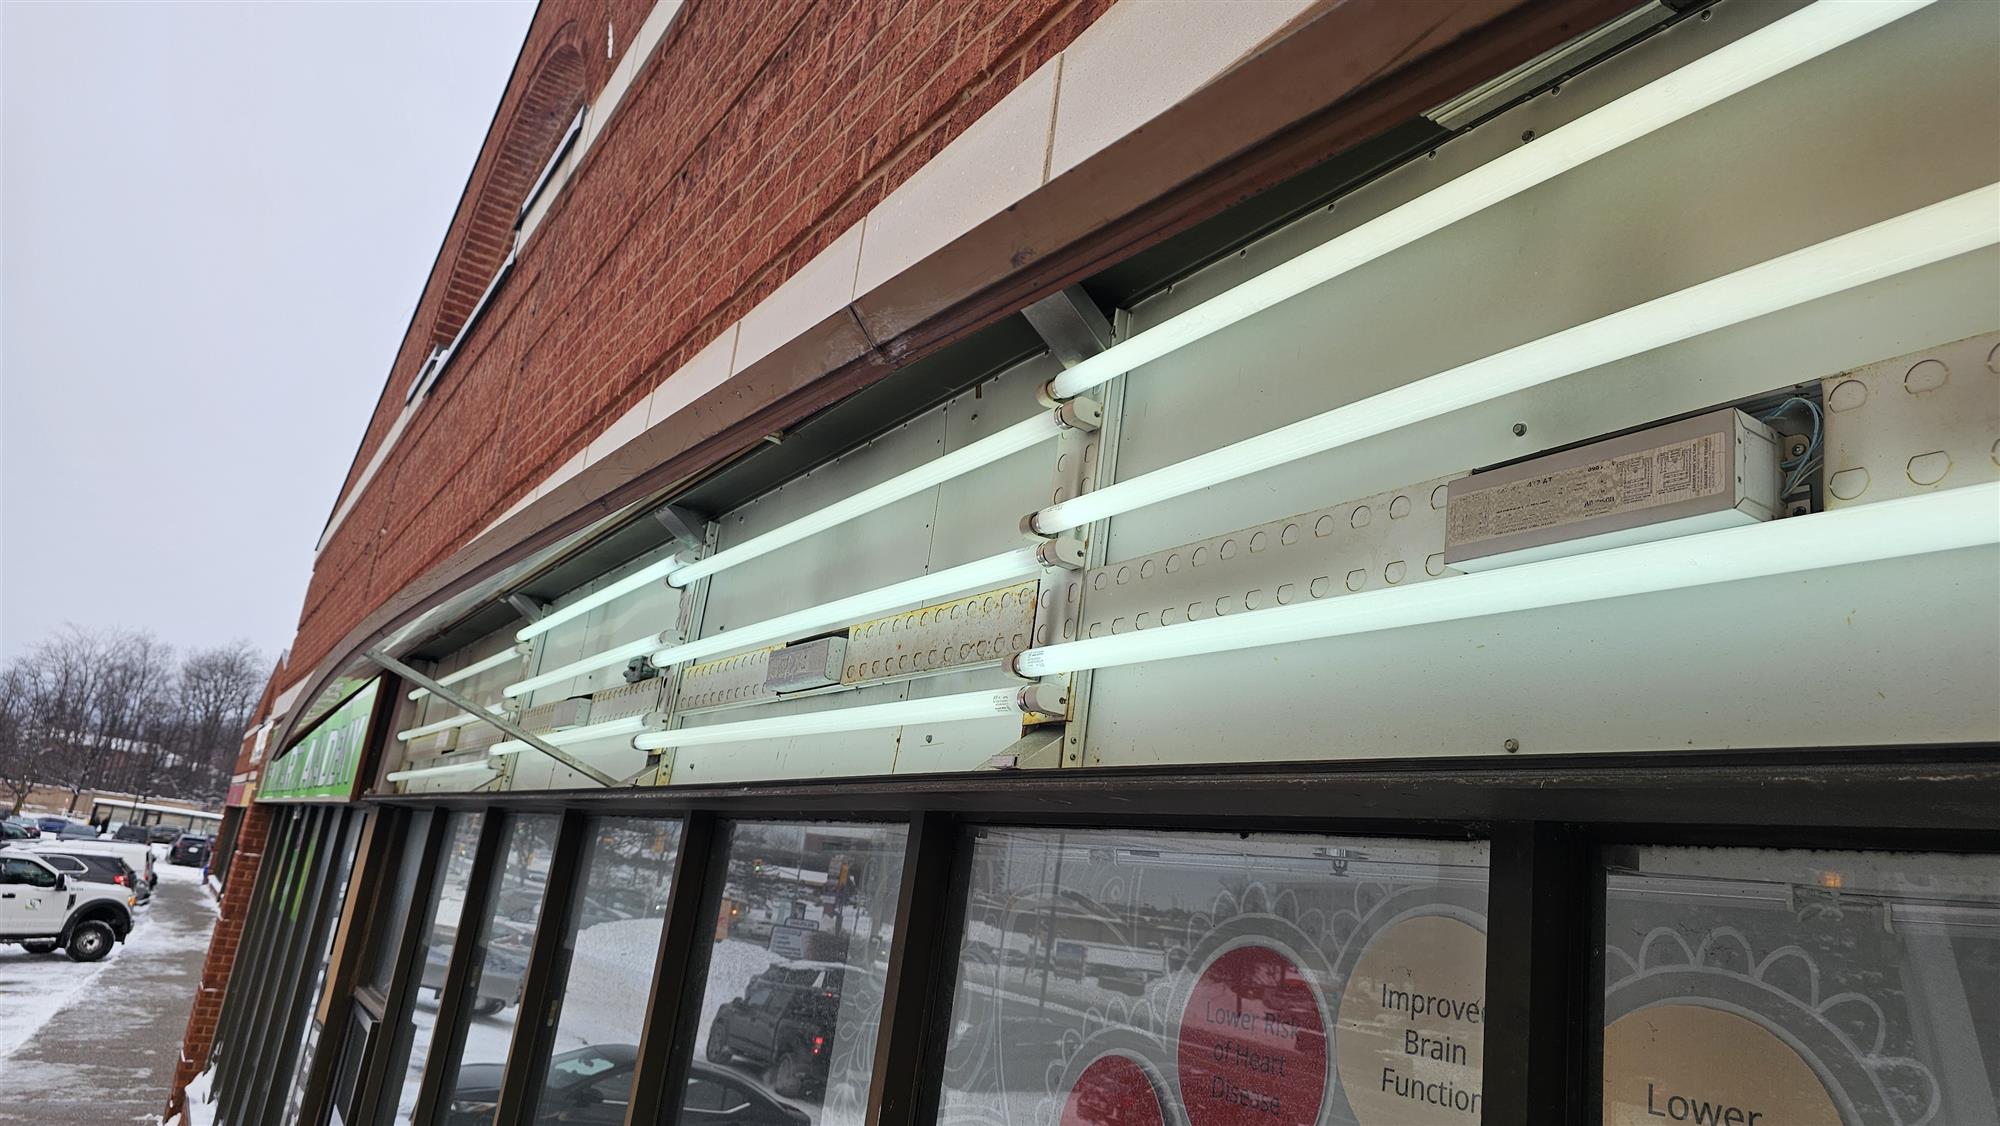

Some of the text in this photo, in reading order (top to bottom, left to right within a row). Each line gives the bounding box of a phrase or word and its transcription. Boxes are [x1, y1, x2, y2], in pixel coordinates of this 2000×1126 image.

[1206, 1000, 1300, 1041] Lower Risk
[1382, 983, 1485, 1024] Improve
[1213, 1040, 1286, 1078] of Heart
[1405, 1029, 1467, 1066] Brain
[1211, 1075, 1280, 1116] Disease
[1648, 1083, 1763, 1126] Lower
